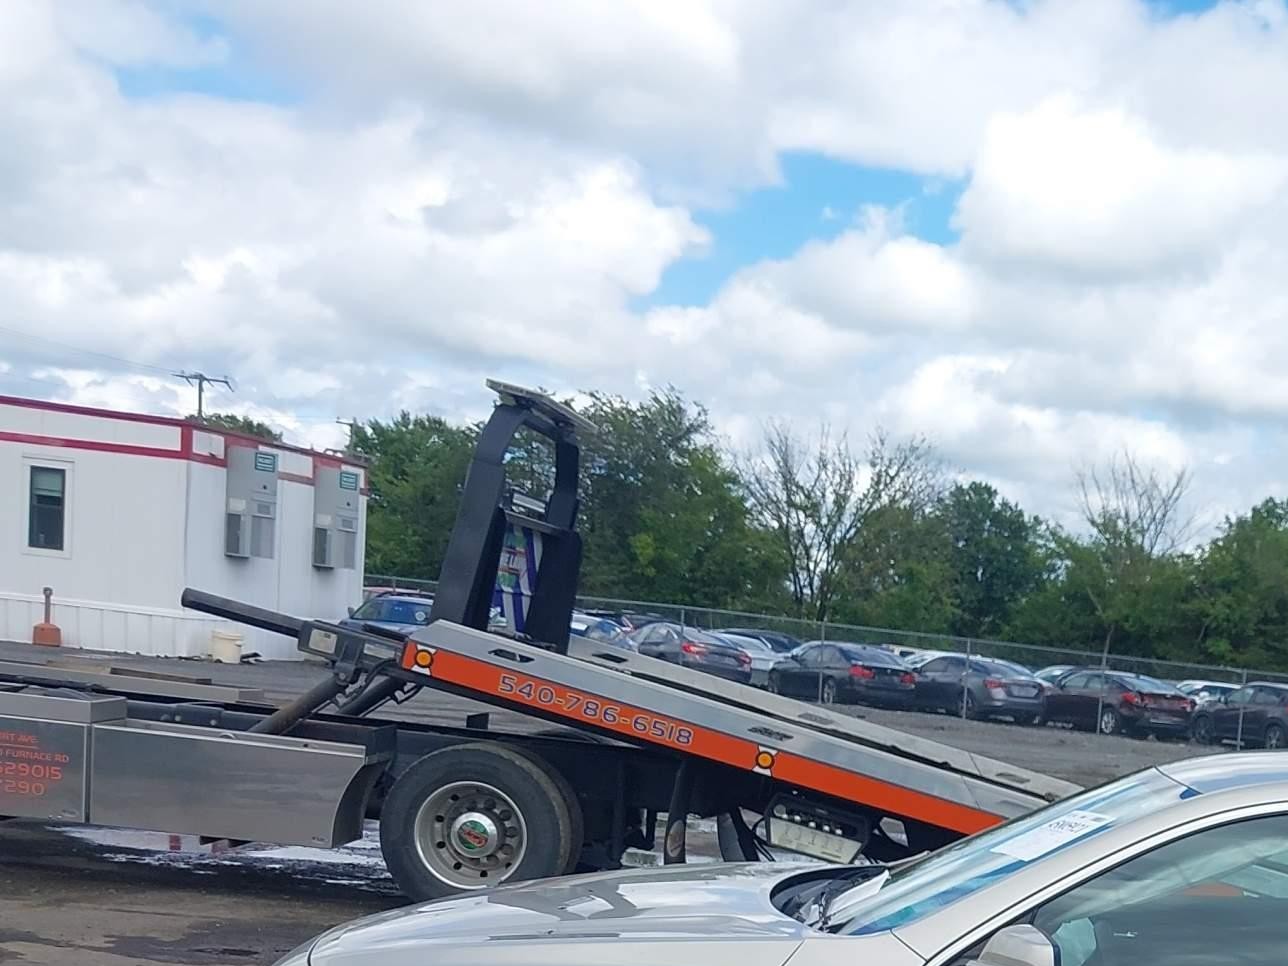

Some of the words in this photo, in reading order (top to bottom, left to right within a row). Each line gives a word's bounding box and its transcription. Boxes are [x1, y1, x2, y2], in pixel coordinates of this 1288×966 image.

[499, 674, 693, 745] 540-786-6518
[54, 753, 70, 763] RD
[0, 779, 45, 796] 290
